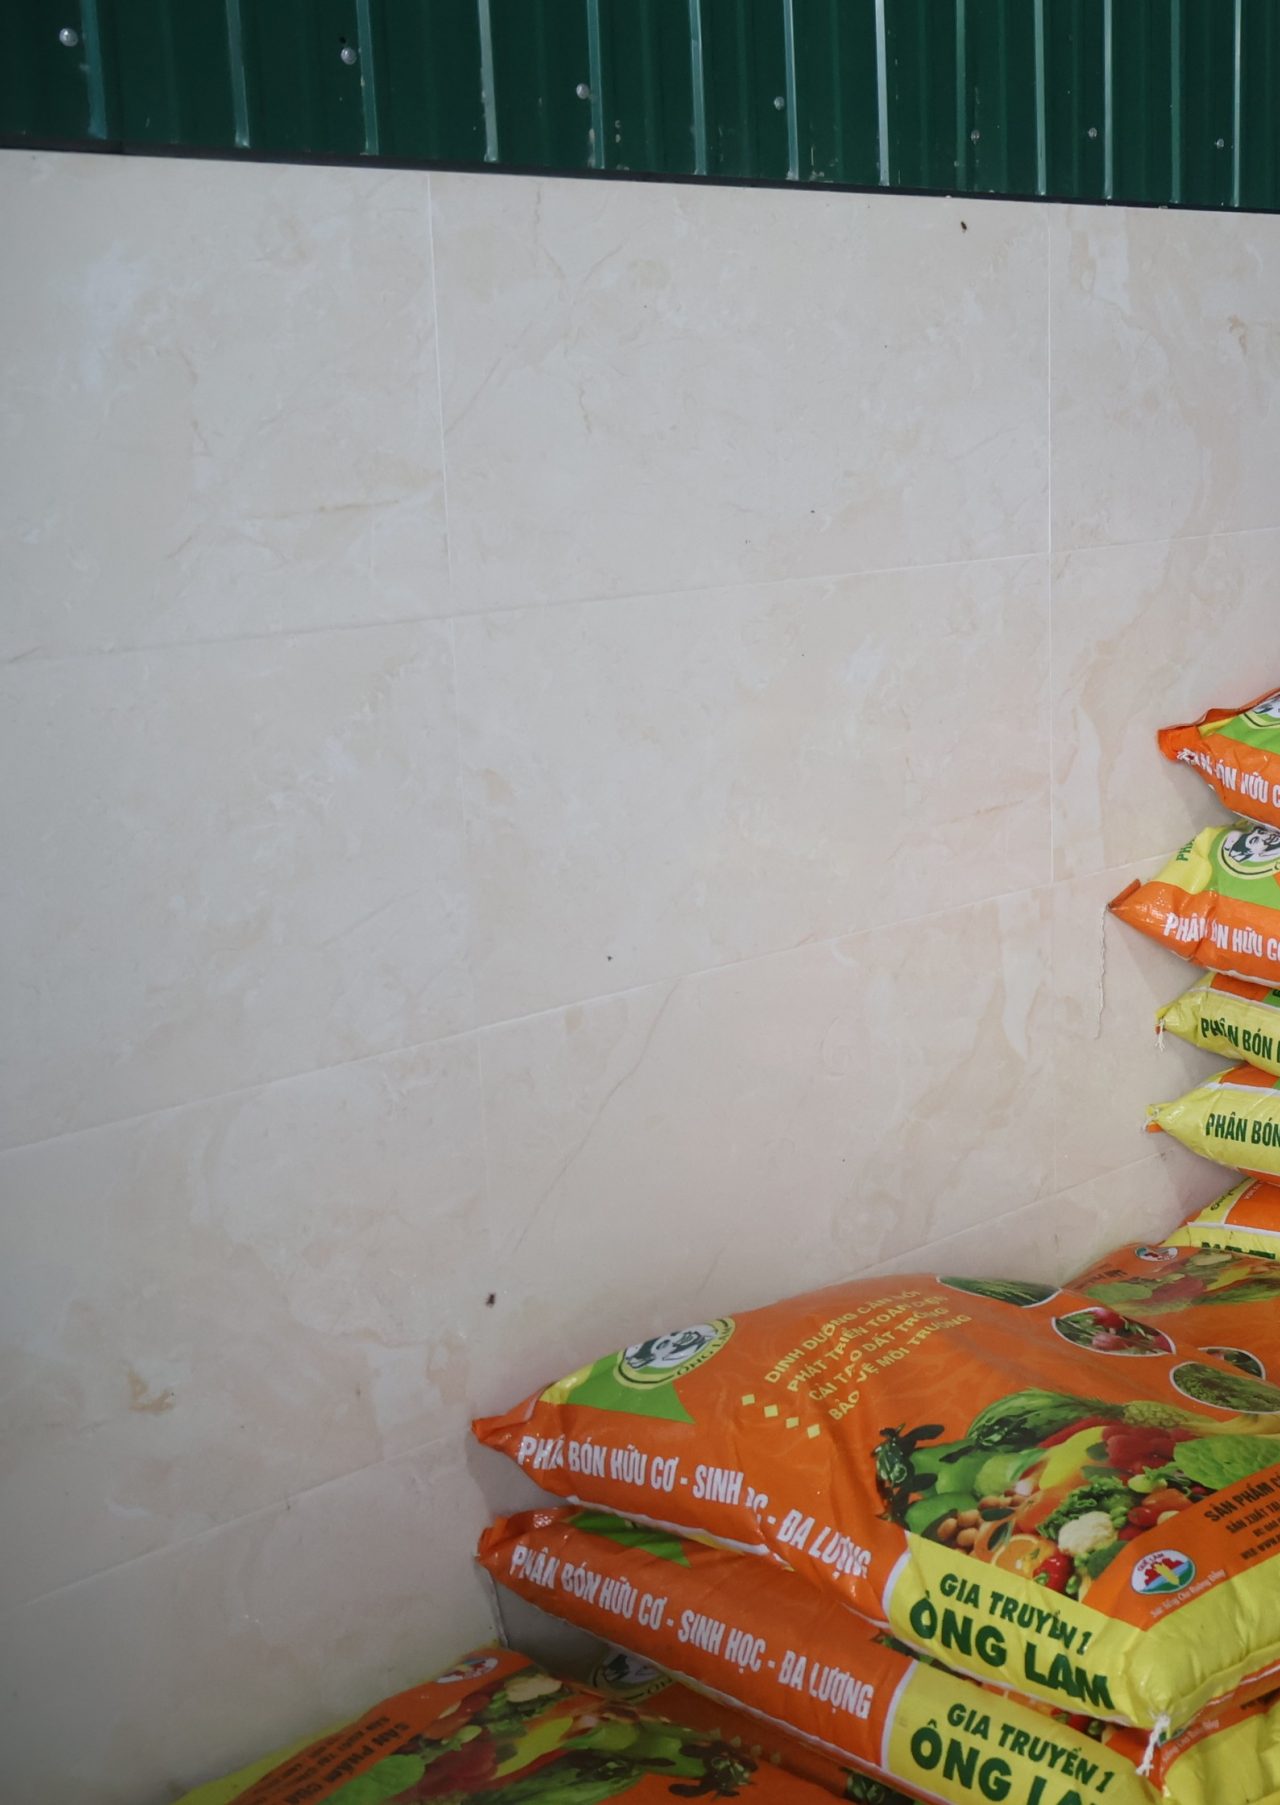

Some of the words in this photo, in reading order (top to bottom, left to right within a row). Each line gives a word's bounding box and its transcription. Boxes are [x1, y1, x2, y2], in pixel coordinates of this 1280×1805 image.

[1232, 924, 1264, 958] HỮU
[1242, 1027, 1273, 1060] BÓN
[1205, 1112, 1248, 1145] PHÂN
[764, 1348, 805, 1384] DINH
[787, 1358, 828, 1392] PHÁT
[828, 1389, 860, 1421] BẢO
[568, 1437, 607, 1478] BÓN
[610, 1444, 648, 1487] HỮU
[651, 1456, 679, 1492] CƠ
[692, 1464, 744, 1506] SINH
[776, 1509, 815, 1550] ĐA
[1204, 1500, 1238, 1523] SẢN
[1232, 1481, 1275, 1507] PHẨM
[509, 1544, 560, 1590] PHÂN
[561, 1559, 602, 1605] BÓN
[598, 1575, 636, 1620] HỮU
[637, 1593, 668, 1631] CƠ
[677, 1609, 726, 1657] SINH
[725, 1626, 767, 1674] HỌC
[778, 1649, 804, 1691] ĐA
[808, 1660, 875, 1719] LƯỢNG
[940, 1573, 980, 1609] GIA
[988, 1590, 1078, 1649] TRUYỀN
[1076, 1631, 1092, 1656] 1
[910, 1590, 1007, 1668] ÔNG
[1024, 1640, 1116, 1710] LAM
[910, 1719, 1013, 1802] ÔNG
[947, 1702, 991, 1741] GIA
[1000, 1722, 1100, 1786] TRUYỀN
[1096, 1771, 1115, 1793] 1
